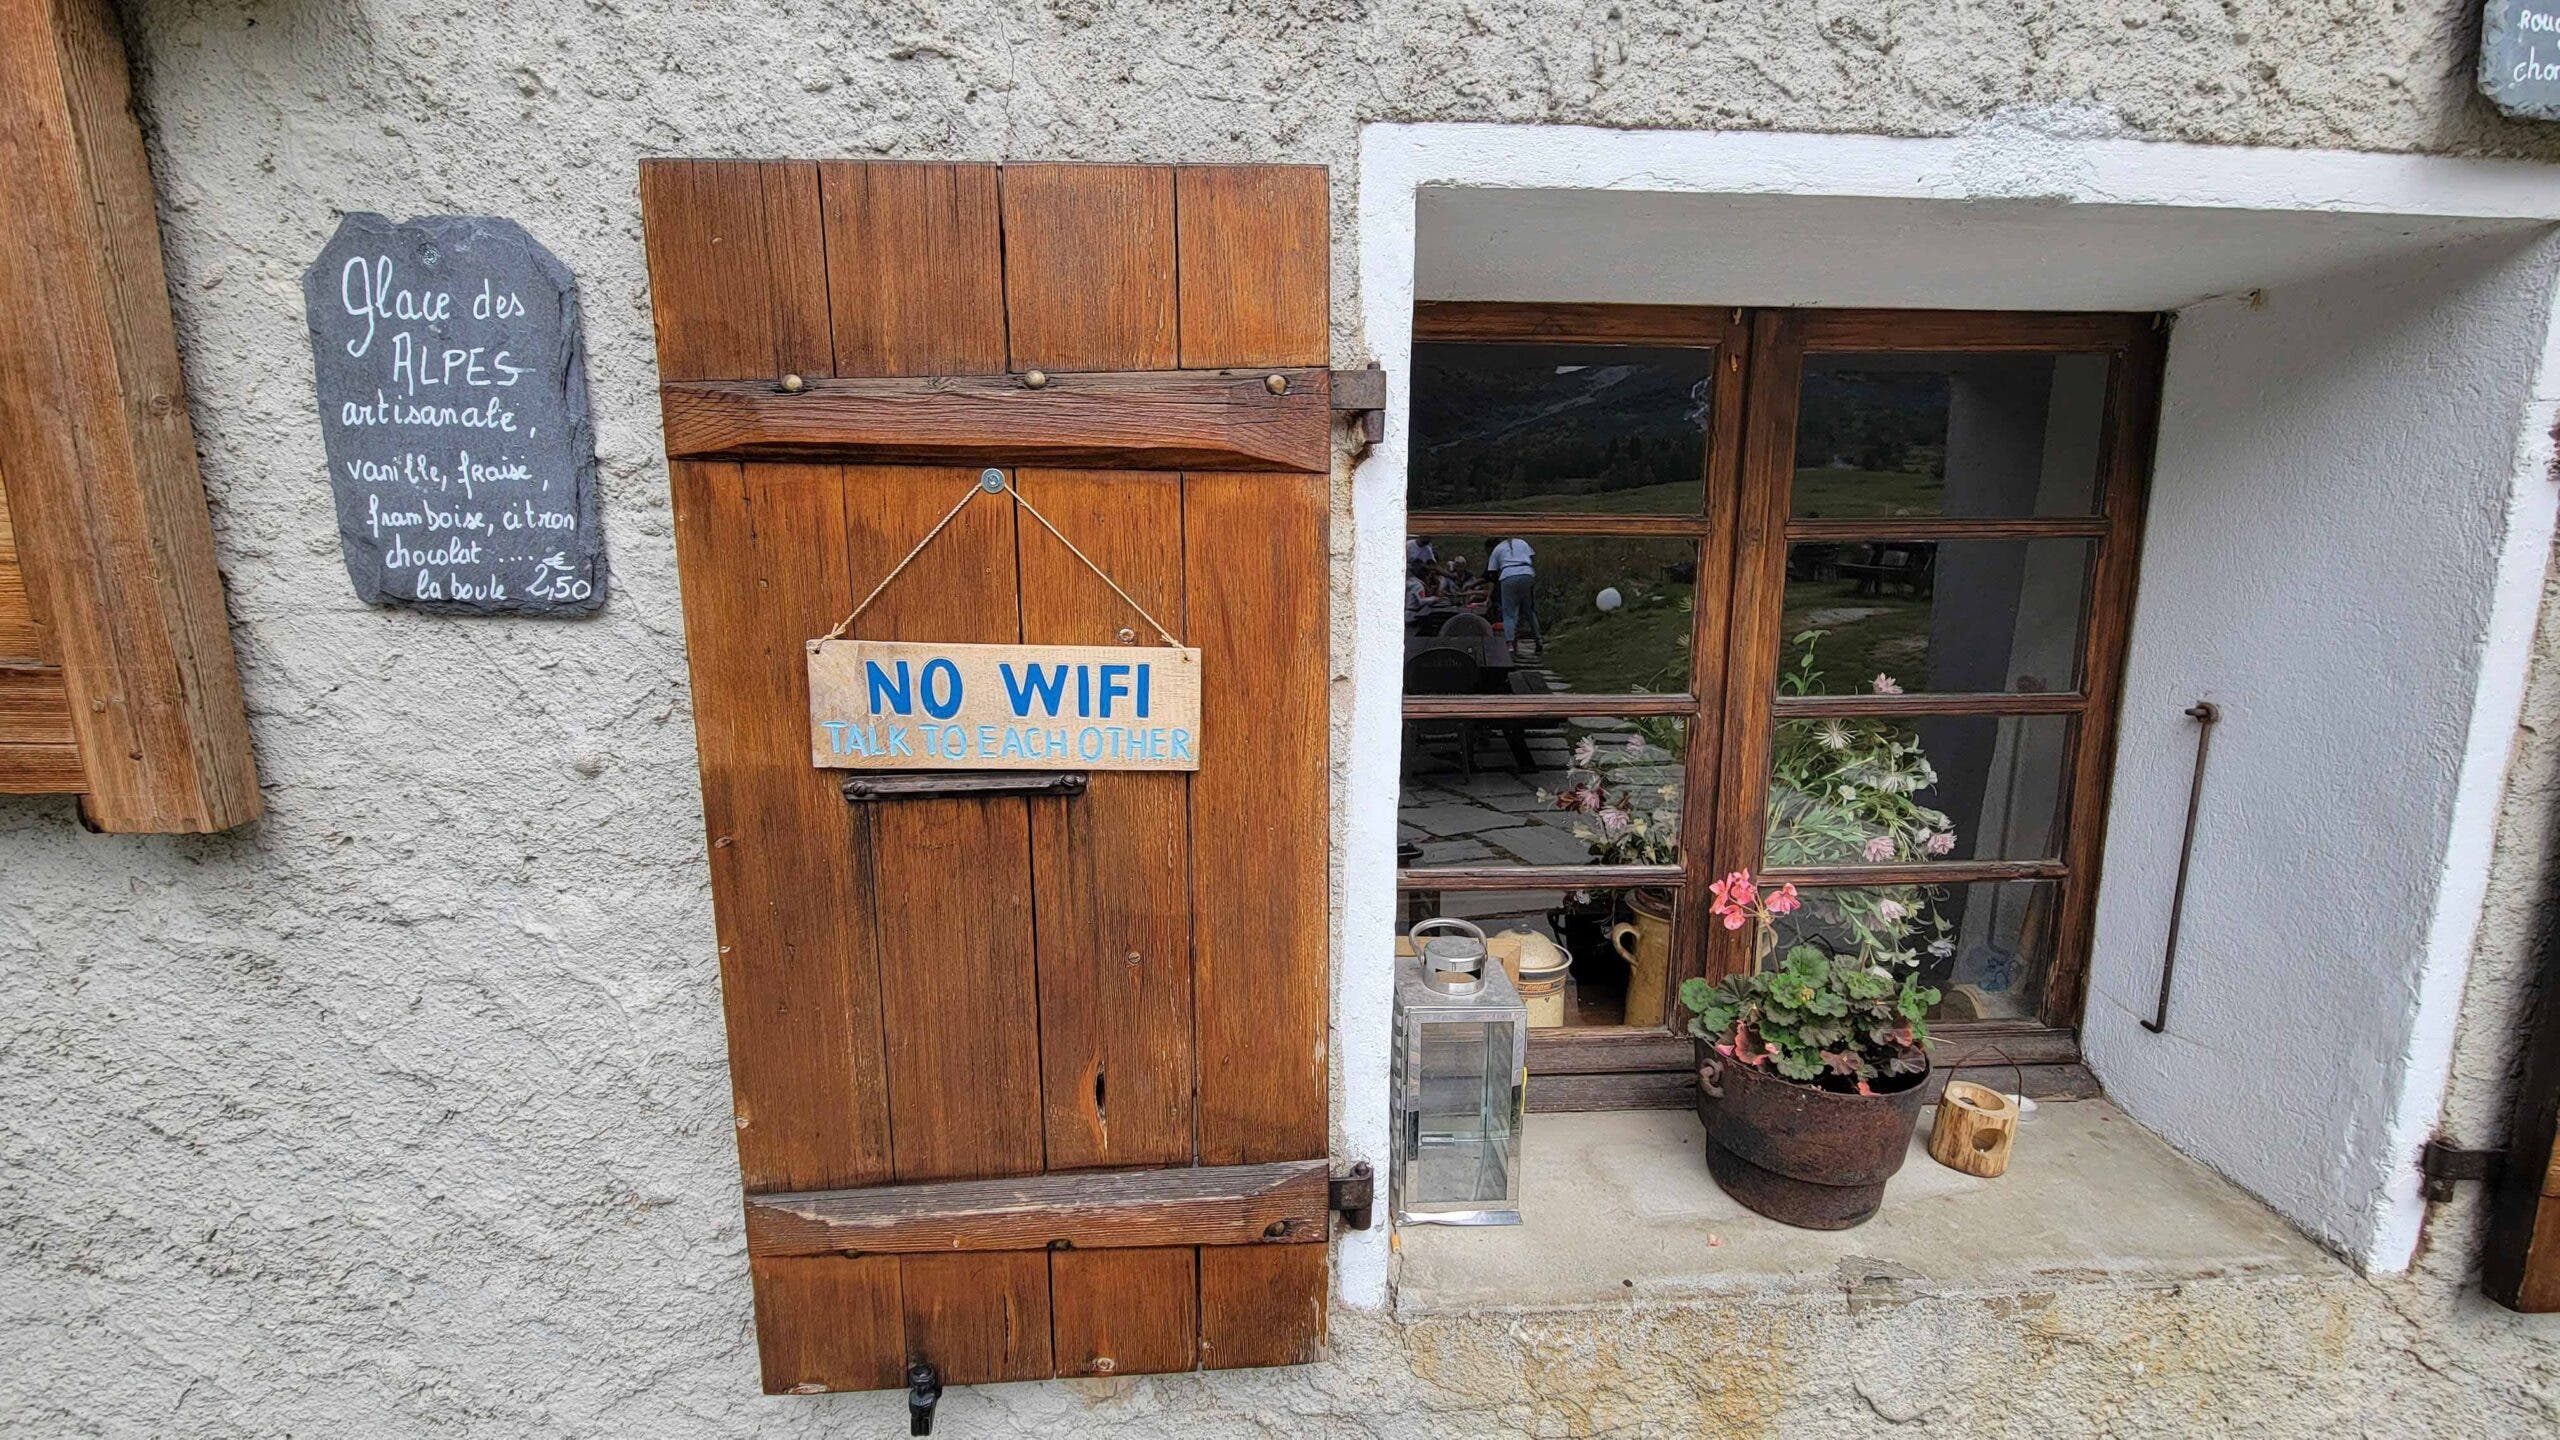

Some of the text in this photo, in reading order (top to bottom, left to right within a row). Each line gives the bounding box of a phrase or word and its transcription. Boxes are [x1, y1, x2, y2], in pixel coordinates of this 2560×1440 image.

[473, 279, 526, 320] des
[393, 332, 536, 395] ALPES
[342, 389, 537, 438] artisanale,
[346, 453, 447, 492] vanille,
[366, 494, 576, 538] framboise, citron
[385, 533, 482, 569] chocolat
[416, 563, 593, 601] la boule 2,50
[864, 657, 1151, 719] NO WIFI
[822, 721, 1192, 763] TALK TO EACH OTHER
